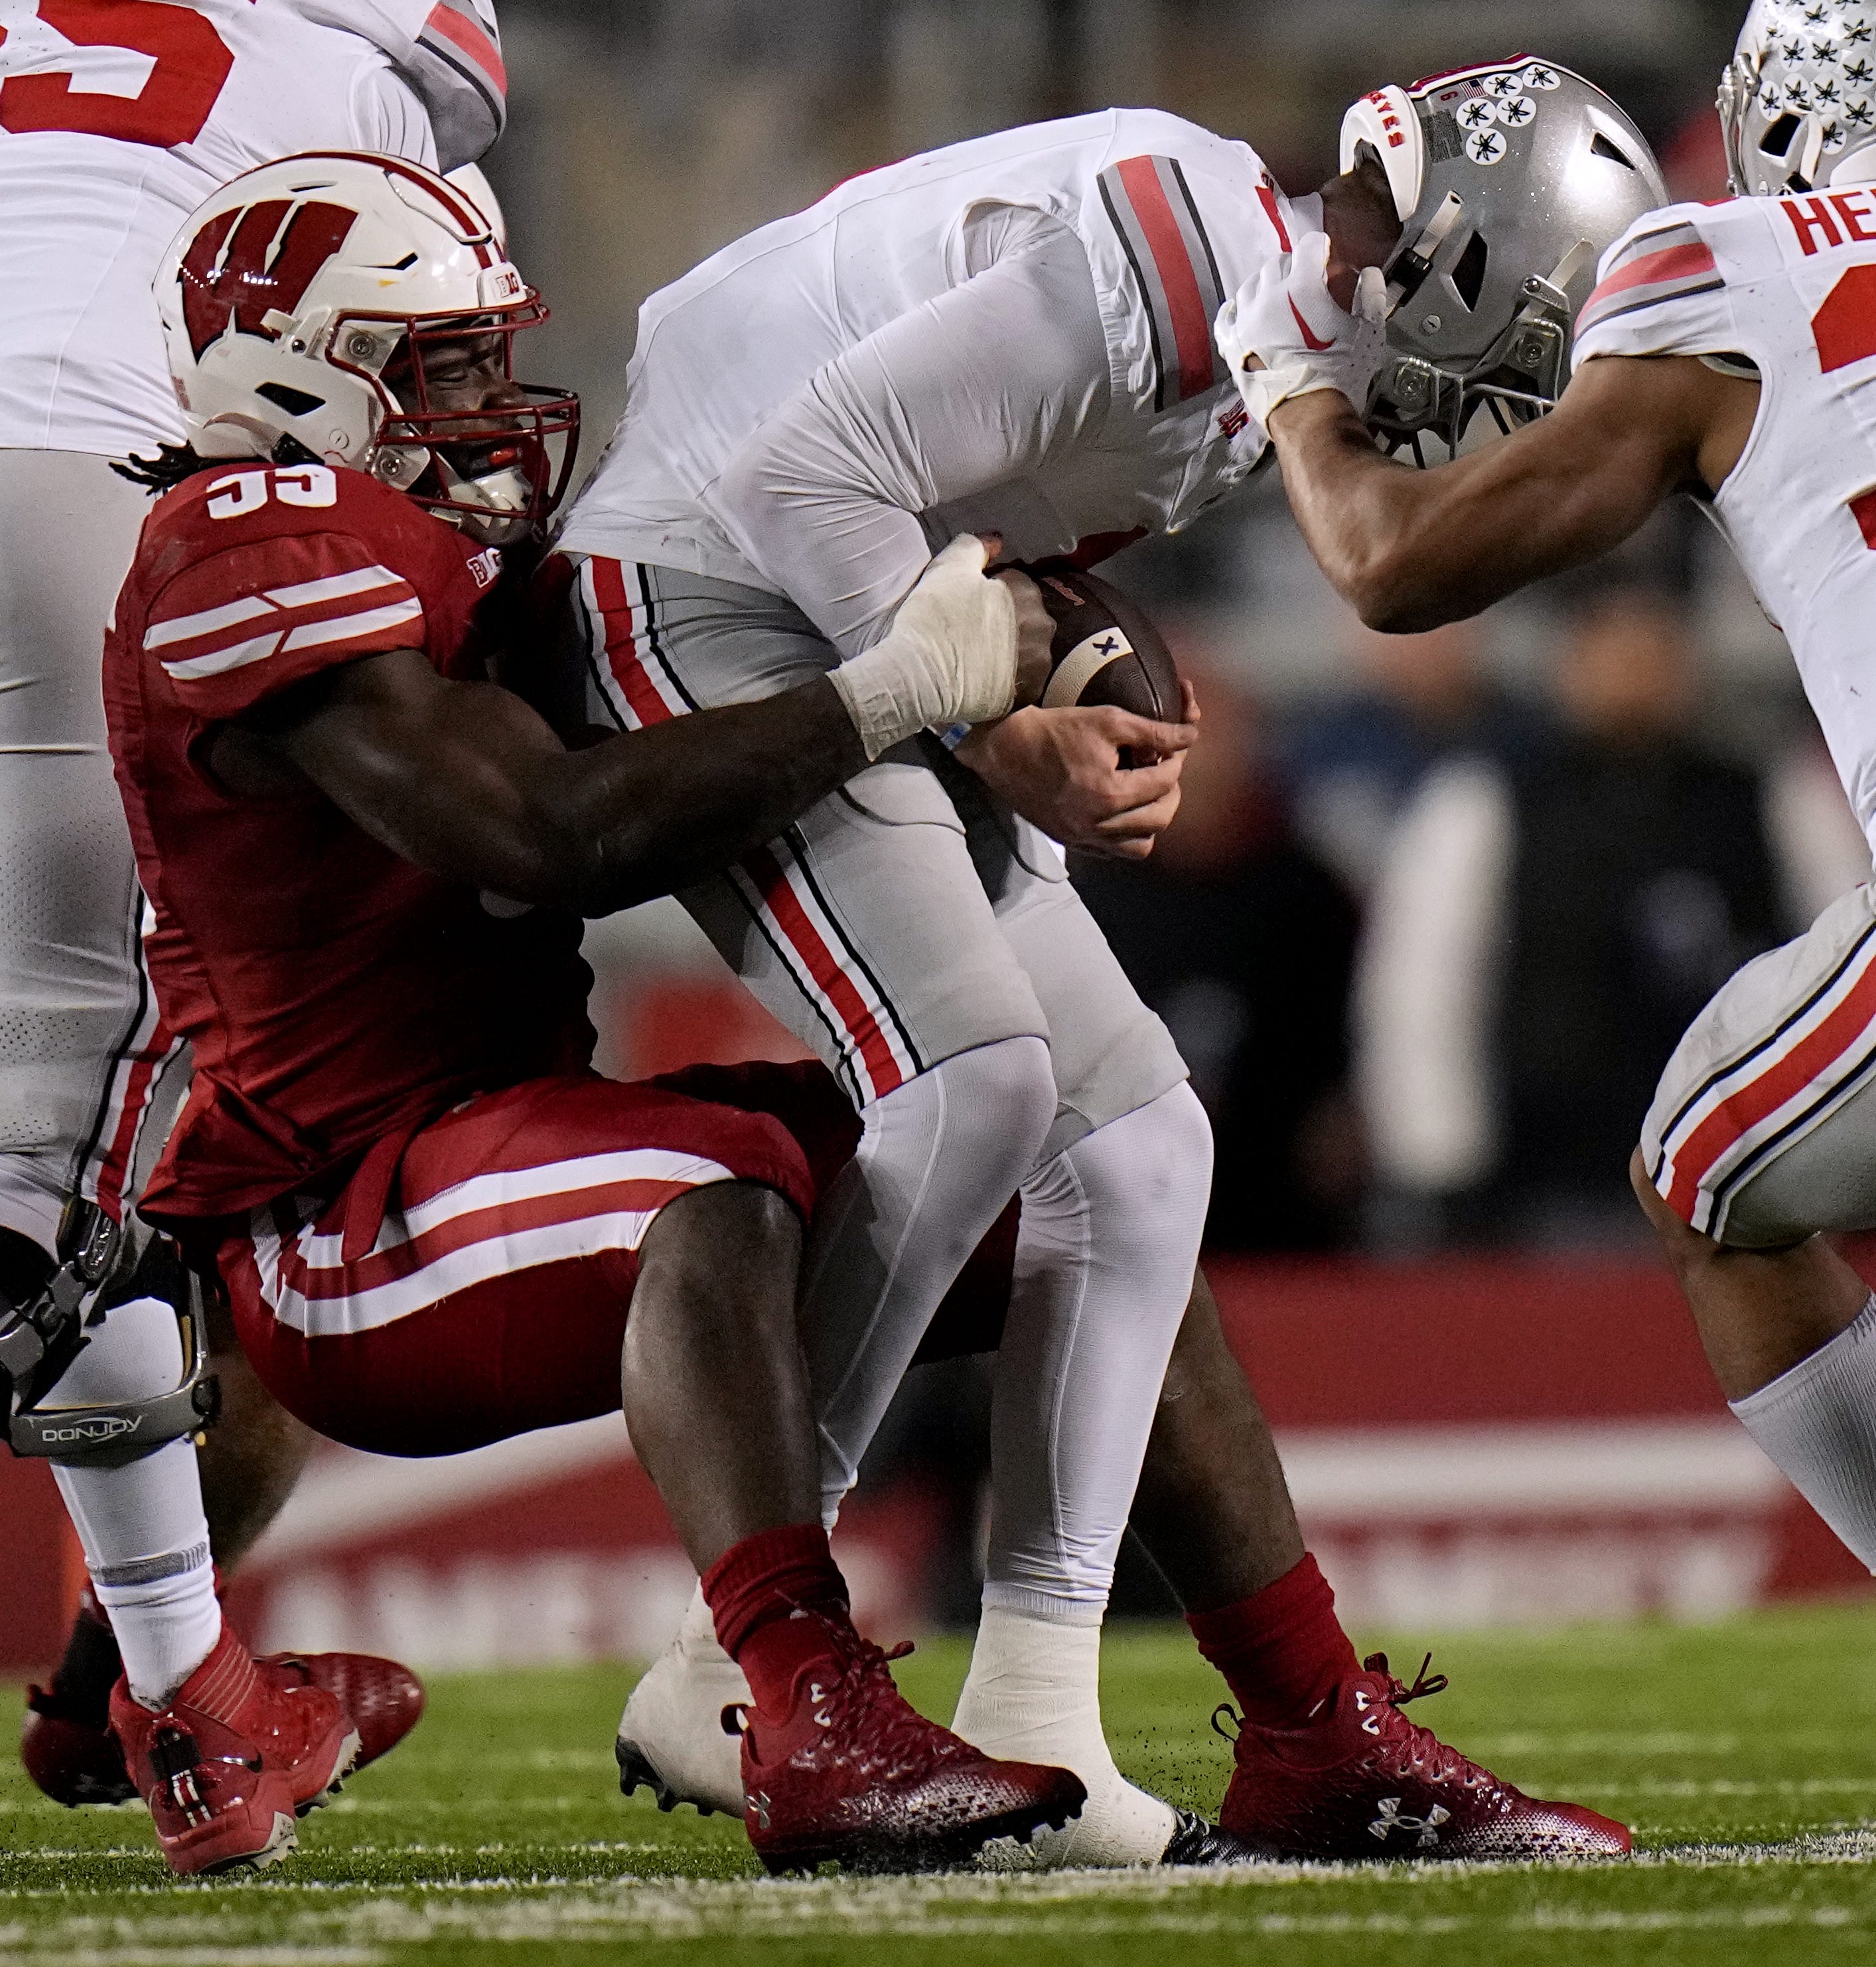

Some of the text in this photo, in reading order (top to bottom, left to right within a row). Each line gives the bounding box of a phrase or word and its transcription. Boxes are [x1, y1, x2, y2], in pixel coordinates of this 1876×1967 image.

[0, 0, 236, 149] 5
[1779, 188, 1876, 256] HE
[42, 1414, 143, 1442] DONJOY
